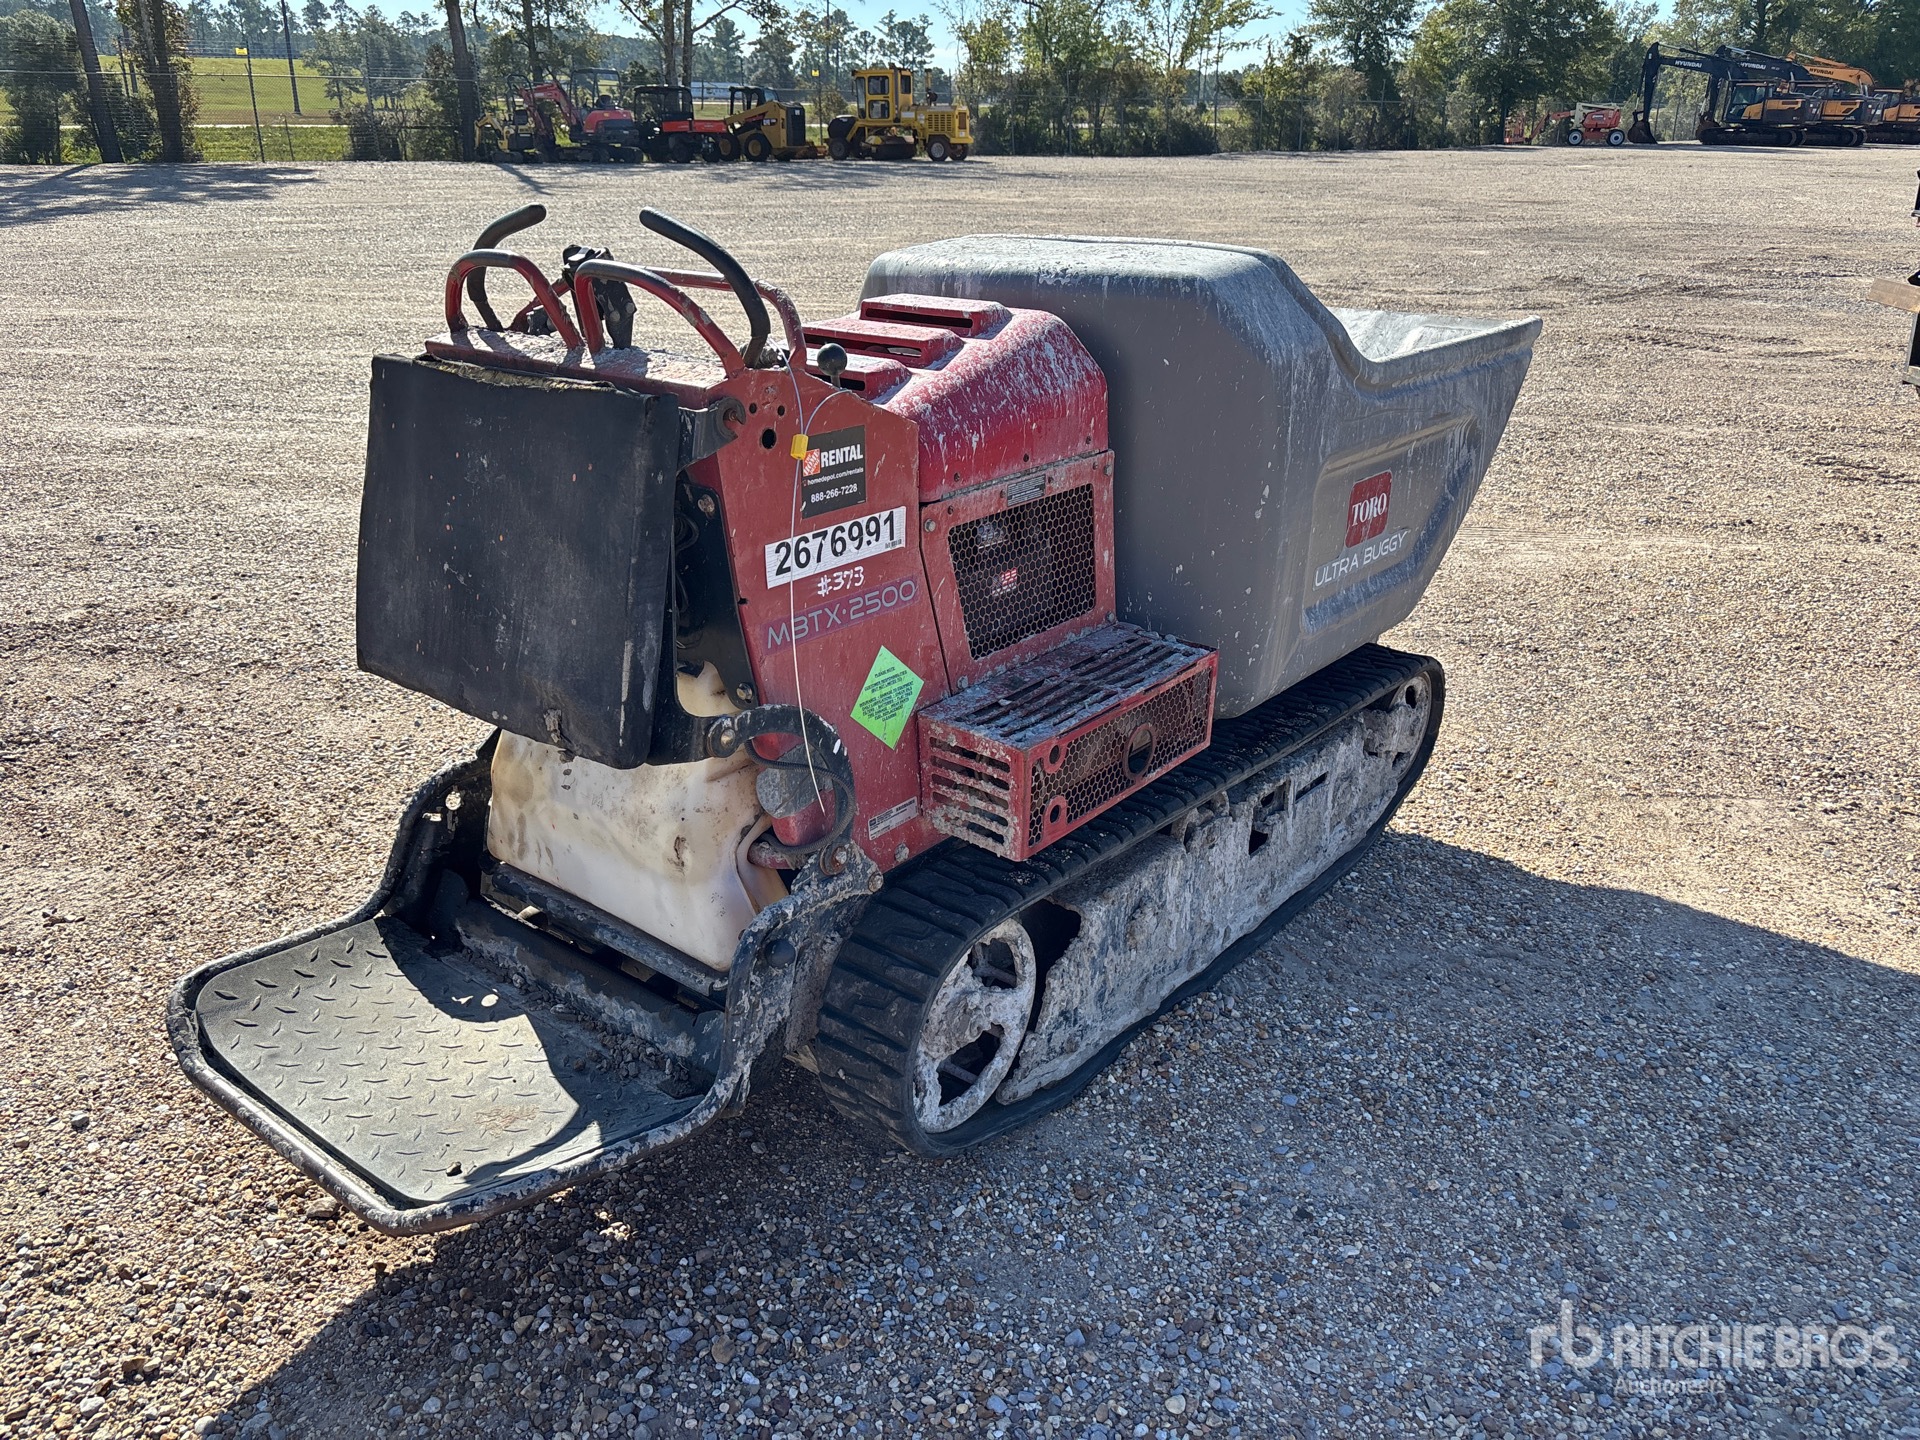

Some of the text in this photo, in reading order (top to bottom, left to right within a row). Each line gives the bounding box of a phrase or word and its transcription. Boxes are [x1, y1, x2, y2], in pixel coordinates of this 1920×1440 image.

[1675, 60, 1703, 69] HYUNDAI
[1740, 62, 1767, 70] HYUNDAI
[1809, 67, 1834, 76] HYUNDAI
[821, 443, 864, 468] RENTAL
[807, 467, 864, 486] homedepot.com/rentals
[811, 483, 858, 503] 888-266-7228
[1352, 492, 1387, 527] TORO
[775, 510, 895, 577] 2676991
[1315, 530, 1408, 587] ULTRA BUGGY
[817, 565, 865, 597] #373
